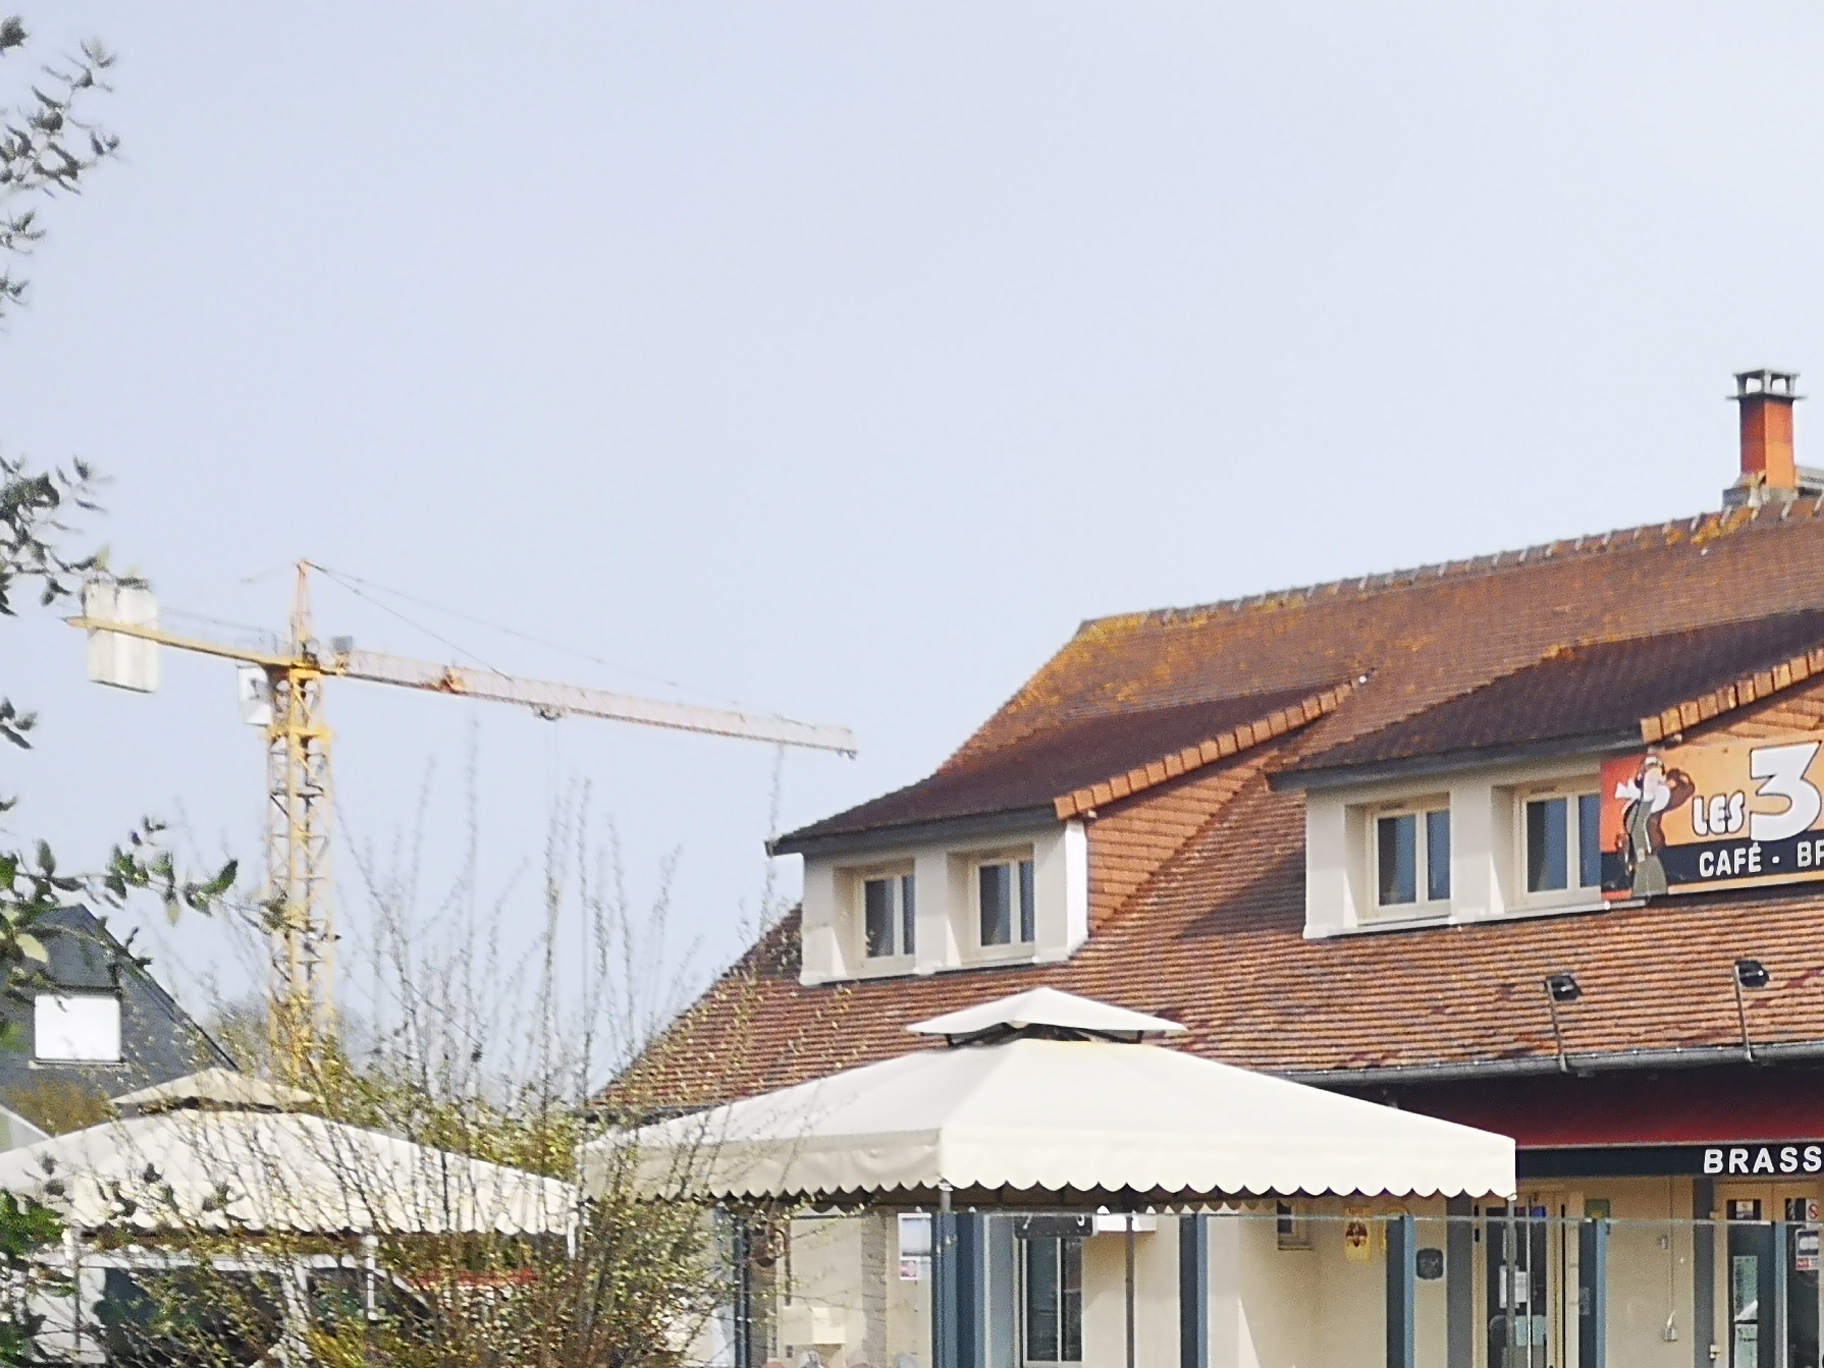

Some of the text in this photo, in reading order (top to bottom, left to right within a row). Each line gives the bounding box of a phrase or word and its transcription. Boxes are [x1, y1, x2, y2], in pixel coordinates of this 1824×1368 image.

[1693, 791, 1746, 836] LES
[1749, 740, 1822, 842] 3
[1699, 842, 1762, 878] CAFÉ
